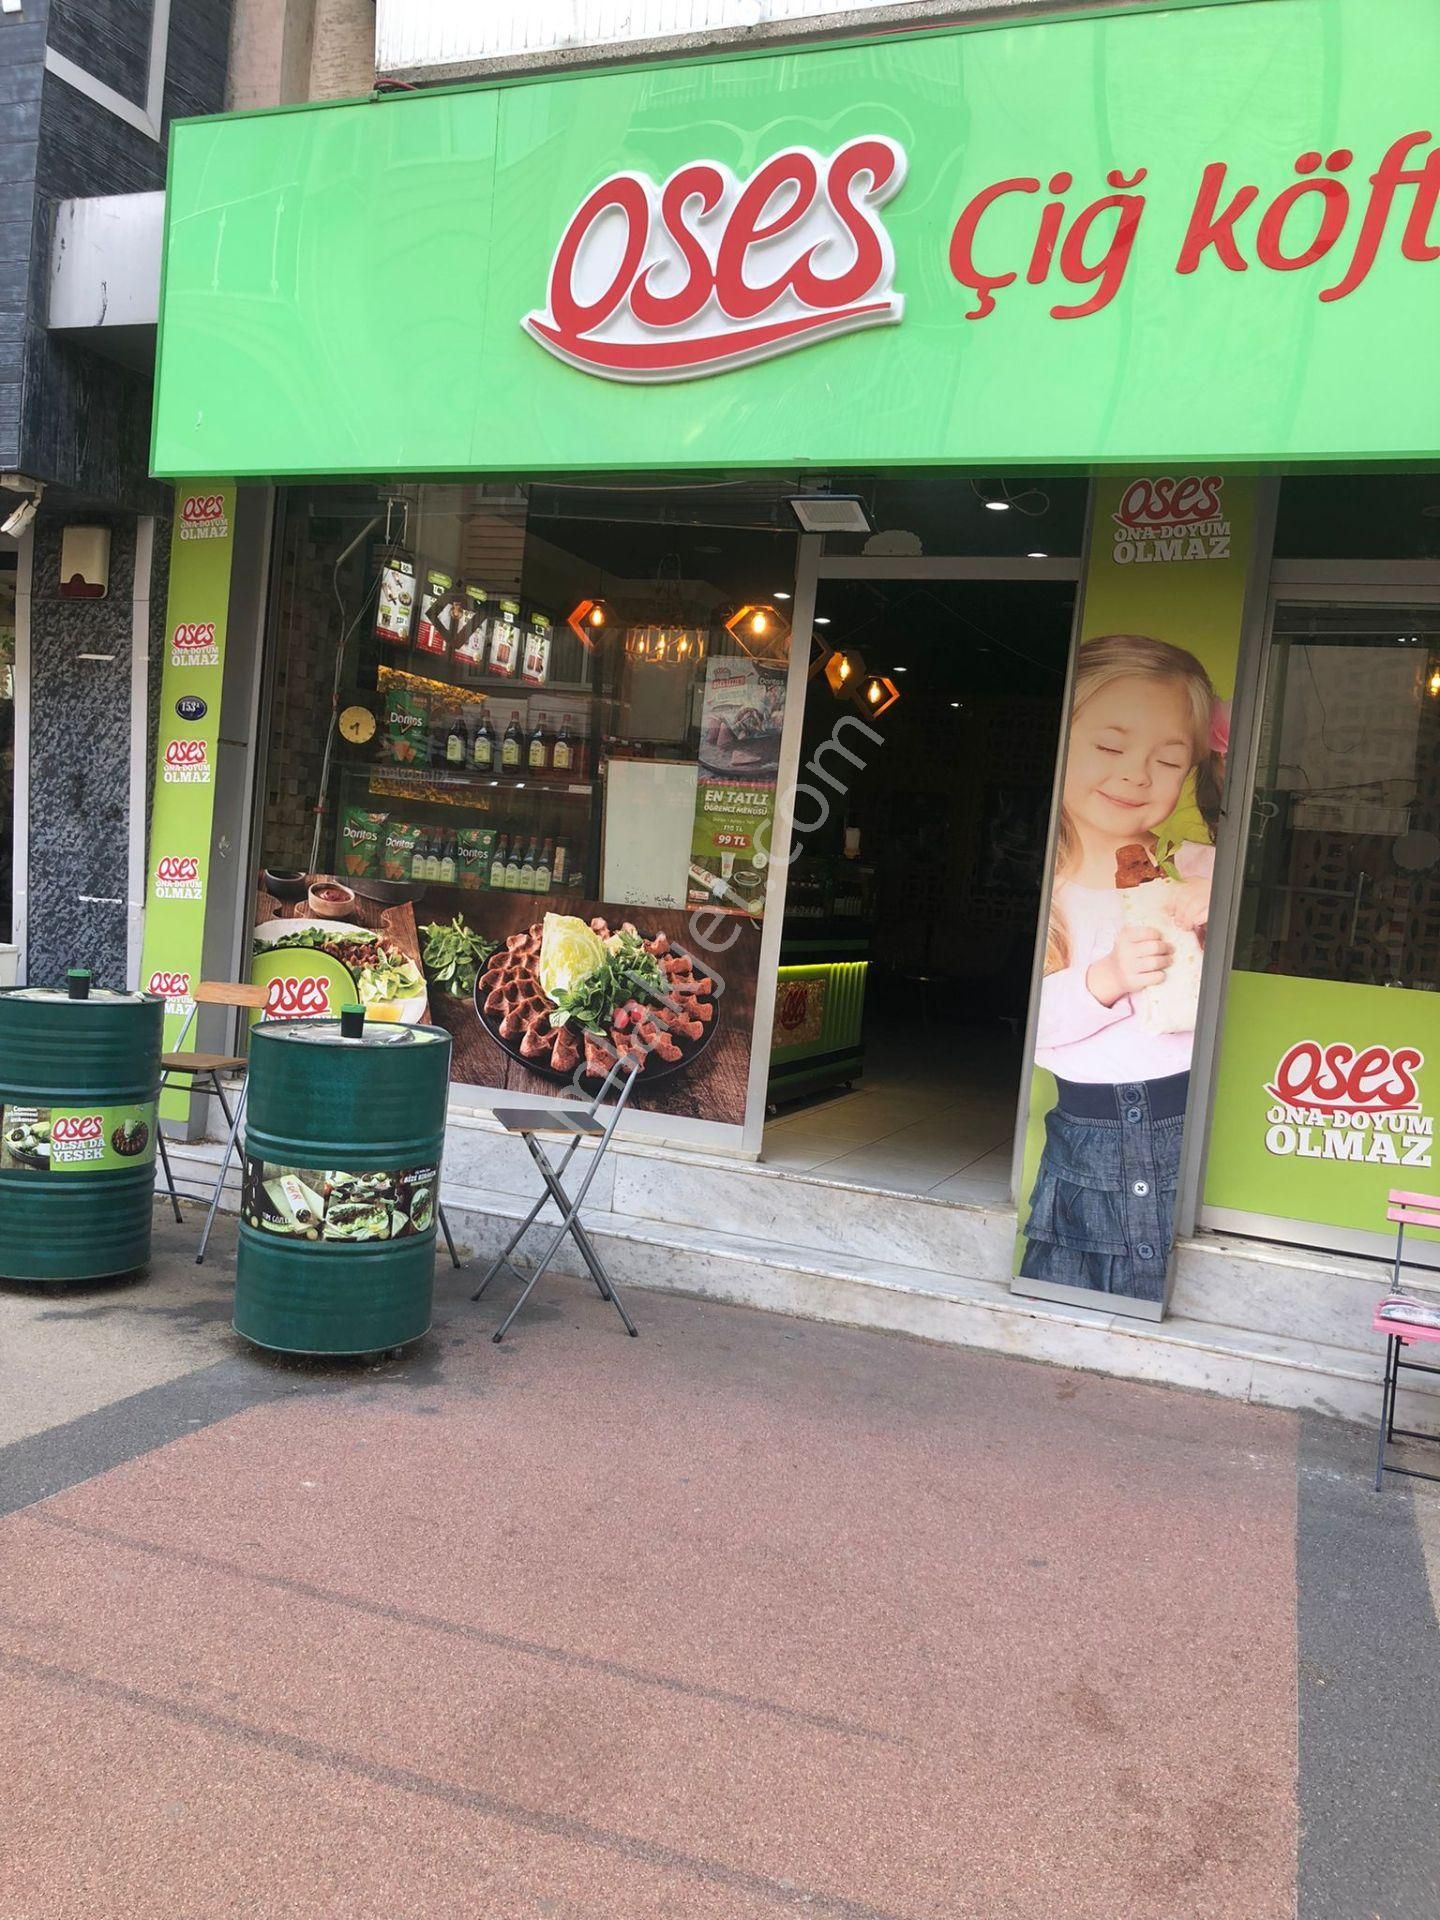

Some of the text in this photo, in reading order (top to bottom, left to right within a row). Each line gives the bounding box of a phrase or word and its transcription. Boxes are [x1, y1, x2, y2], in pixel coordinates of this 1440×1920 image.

[948, 167, 1147, 320] Çiğ
[180, 526, 228, 541] OLMAZ
[1114, 520, 1231, 541] ONA DOYUM
[1112, 536, 1231, 564] OLMAZ
[171, 653, 219, 667] OLMAZ
[390, 711, 423, 727] Doritos
[163, 771, 211, 783] OLMAZ
[705, 789, 768, 805] EN TATLI
[343, 827, 378, 841] Doritos
[718, 834, 746, 846] 99 TL
[386, 837, 415, 849] Doritos
[155, 887, 202, 899] OLMAZ
[1267, 1106, 1434, 1136] ONA DOYUM
[1265, 1125, 1434, 1168] OLMAZ
[53, 1148, 104, 1162] YESEK
